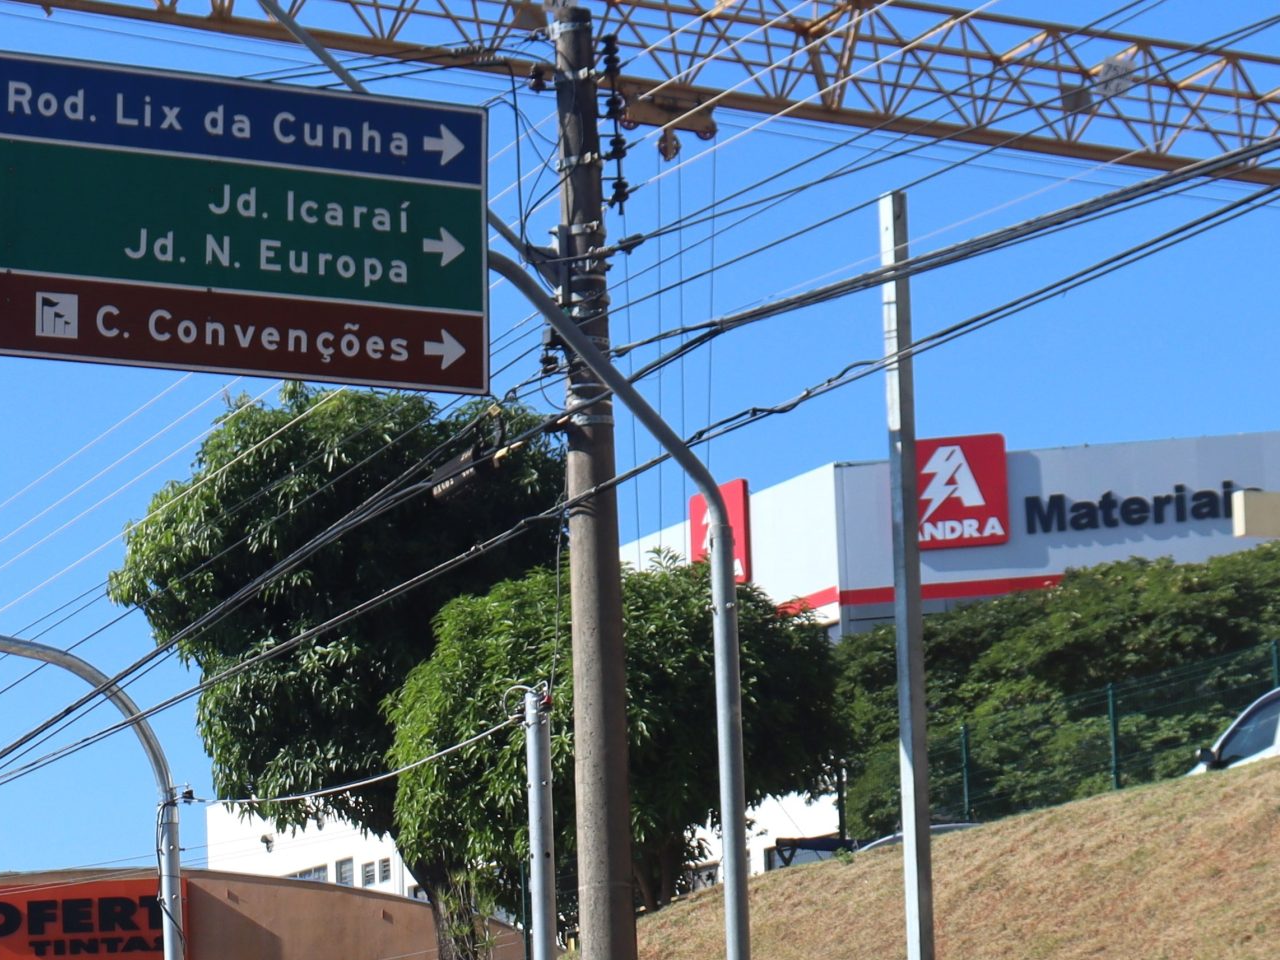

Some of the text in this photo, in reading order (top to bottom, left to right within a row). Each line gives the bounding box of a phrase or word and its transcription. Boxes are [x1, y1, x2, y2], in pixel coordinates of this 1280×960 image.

[7, 80, 409, 157] Rod. Lix da Cunha
[208, 183, 411, 233] Jd. Icaraí
[124, 228, 409, 288] Jd. N. Europa
[95, 304, 410, 364] C. Convenções
[1024, 479, 1263, 535] Materiai
